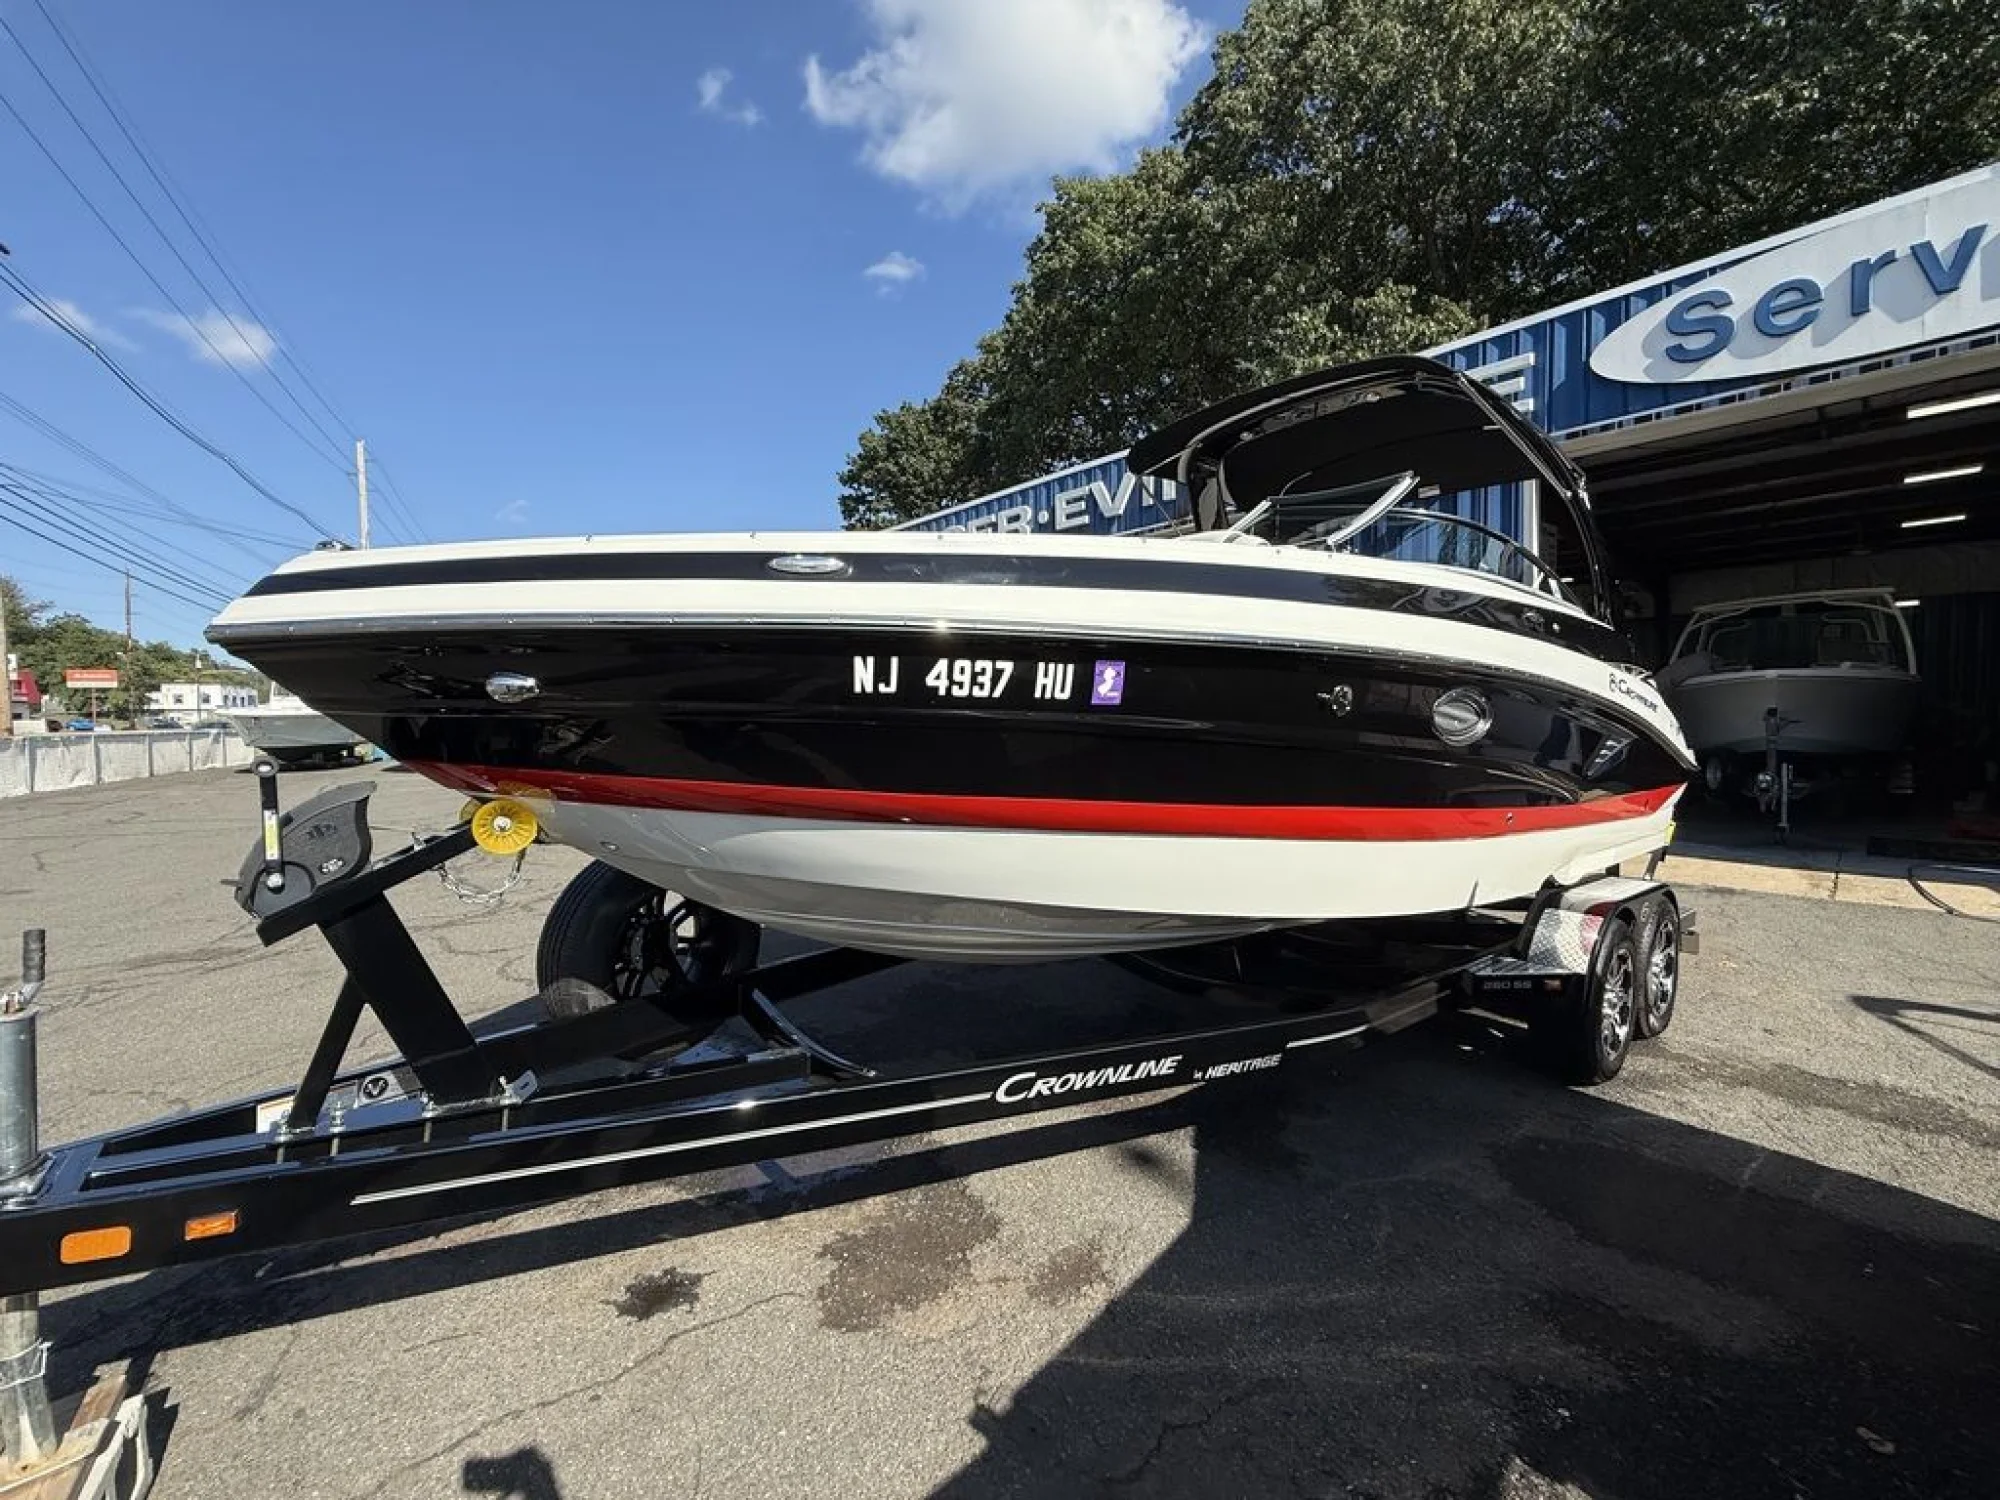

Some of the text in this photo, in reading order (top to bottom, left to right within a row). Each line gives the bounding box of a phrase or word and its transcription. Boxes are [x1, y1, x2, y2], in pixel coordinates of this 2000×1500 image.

[853, 656, 899, 693] NJ
[925, 658, 1015, 697] 4937
[1034, 662, 1075, 699] HU
[1204, 1053, 1282, 1079] HERITAGE
